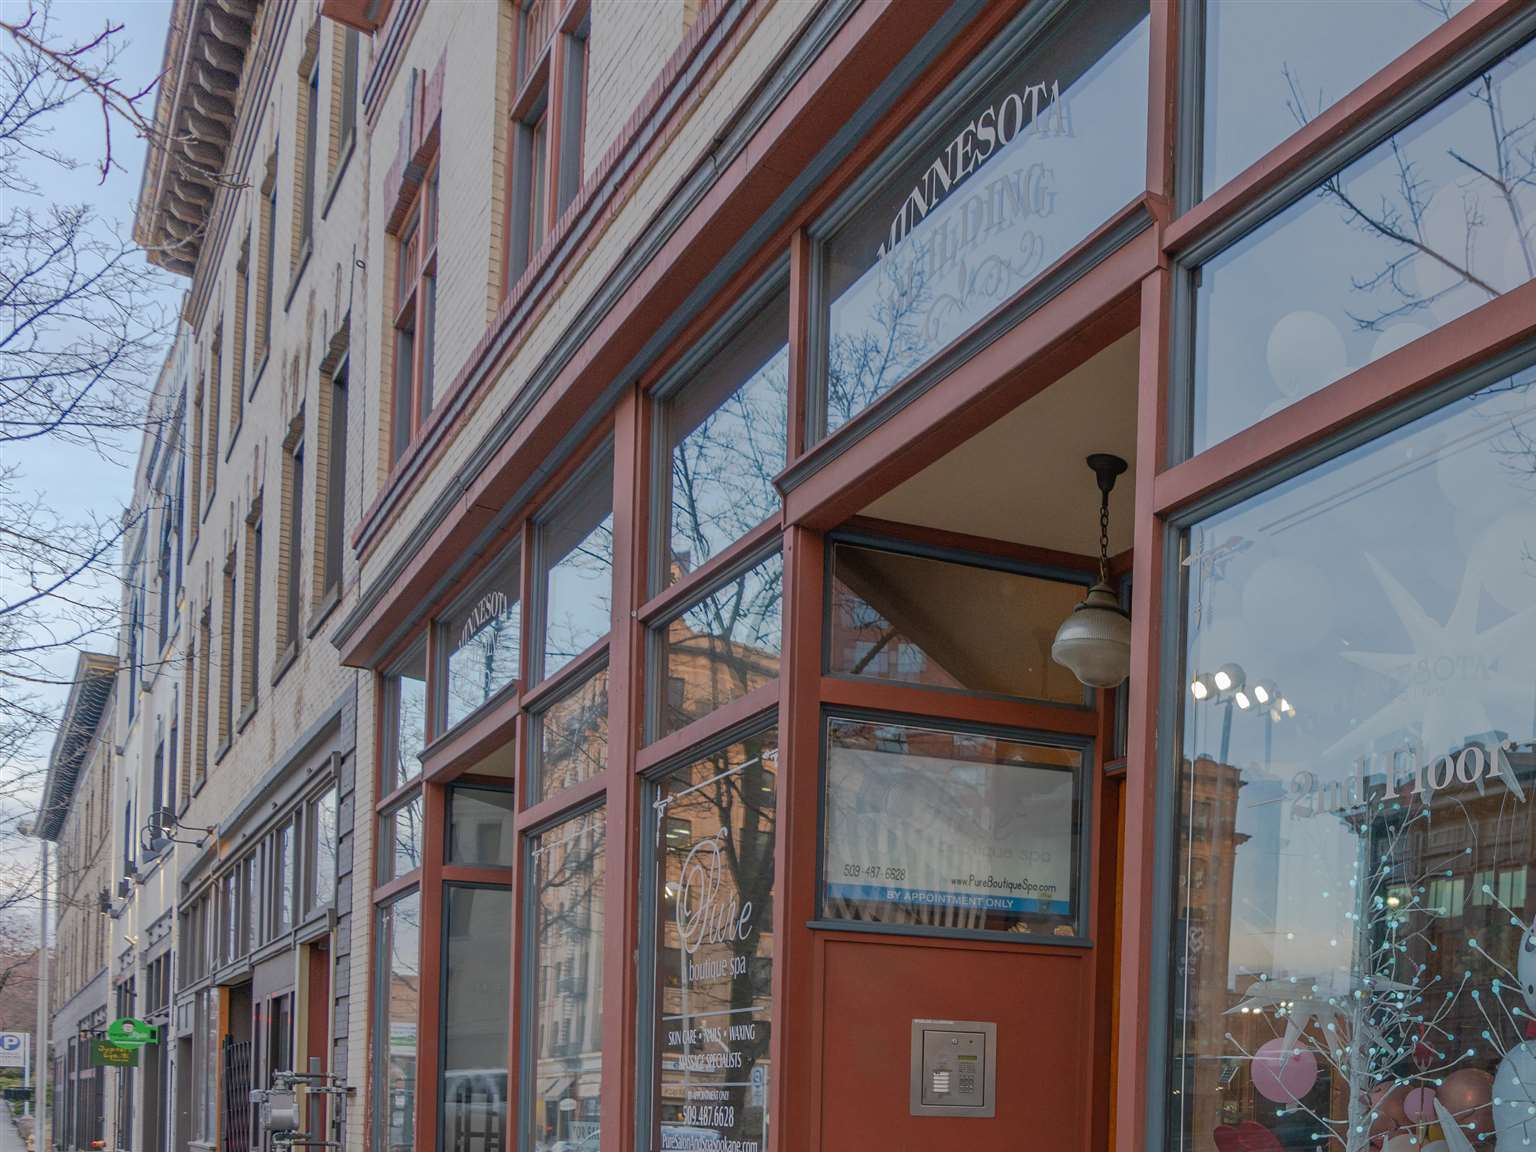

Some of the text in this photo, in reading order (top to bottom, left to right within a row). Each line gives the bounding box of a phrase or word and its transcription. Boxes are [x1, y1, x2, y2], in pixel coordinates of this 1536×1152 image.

[1376, 740, 1517, 800] Floor
[887, 890, 1014, 909] BY APPOINTMENT ONLY
[689, 955, 747, 982] boutique spa
[668, 1031, 682, 1046] SKIN
[682, 1029, 697, 1045] CARE
[729, 1024, 756, 1040] WAXING
[706, 1052, 742, 1068] SPECIALISTS
